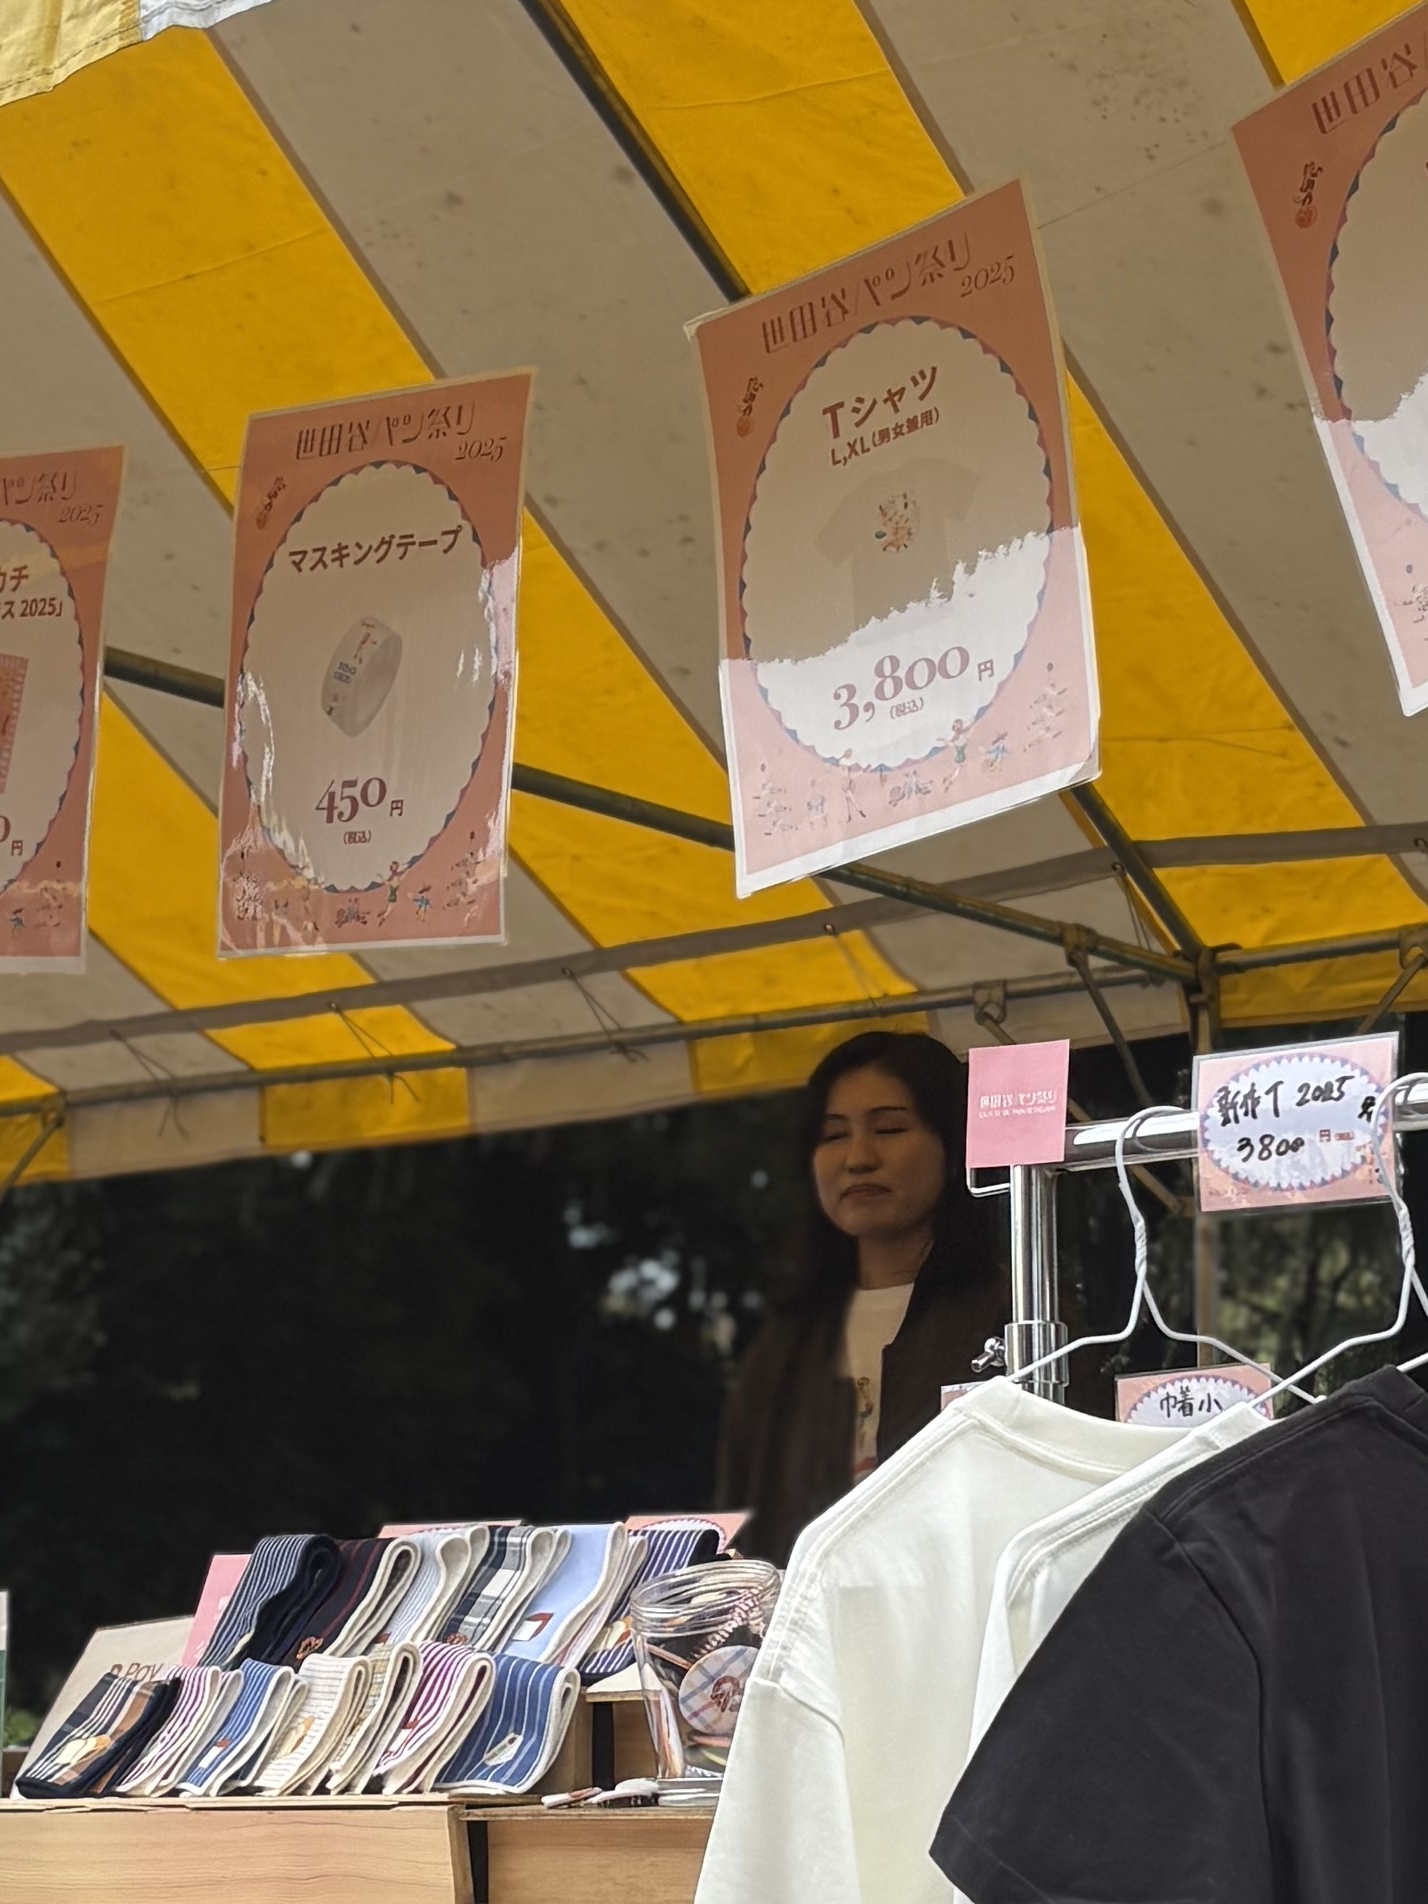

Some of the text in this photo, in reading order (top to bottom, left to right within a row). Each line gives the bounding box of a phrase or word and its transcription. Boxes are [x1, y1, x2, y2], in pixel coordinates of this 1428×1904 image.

[760, 230, 972, 357] 世田谷パン祭り
[959, 254, 1018, 300] 2025
[820, 364, 939, 436] Tシャツ
[294, 403, 475, 460] 世田谷パン祭り
[454, 436, 507, 463] 2025
[57, 504, 103, 526] 2025
[288, 526, 463, 573] マスキングテープ
[1237, 1133, 1305, 1162] 3800
